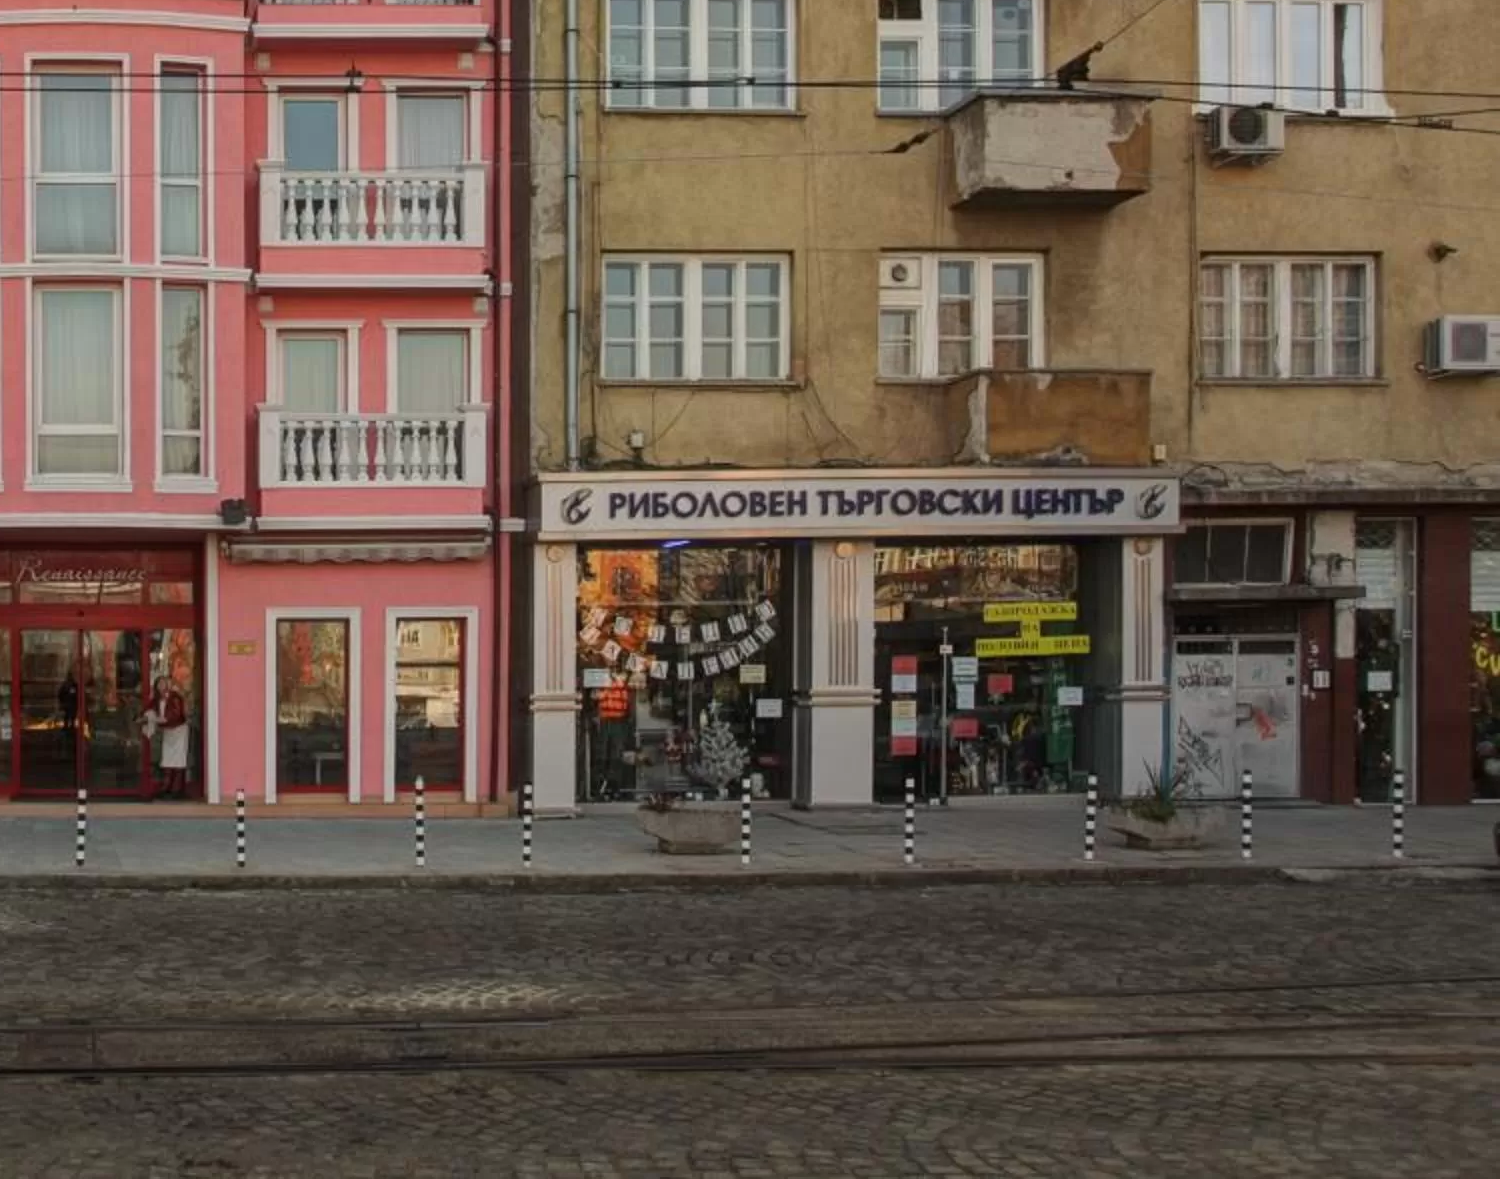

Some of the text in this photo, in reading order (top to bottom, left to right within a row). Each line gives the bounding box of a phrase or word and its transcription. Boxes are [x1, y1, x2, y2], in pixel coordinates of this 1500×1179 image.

[608, 487, 1125, 519] РИБОЛОВЕН ТЪРГОВСКИ ЦЕНТЪР
